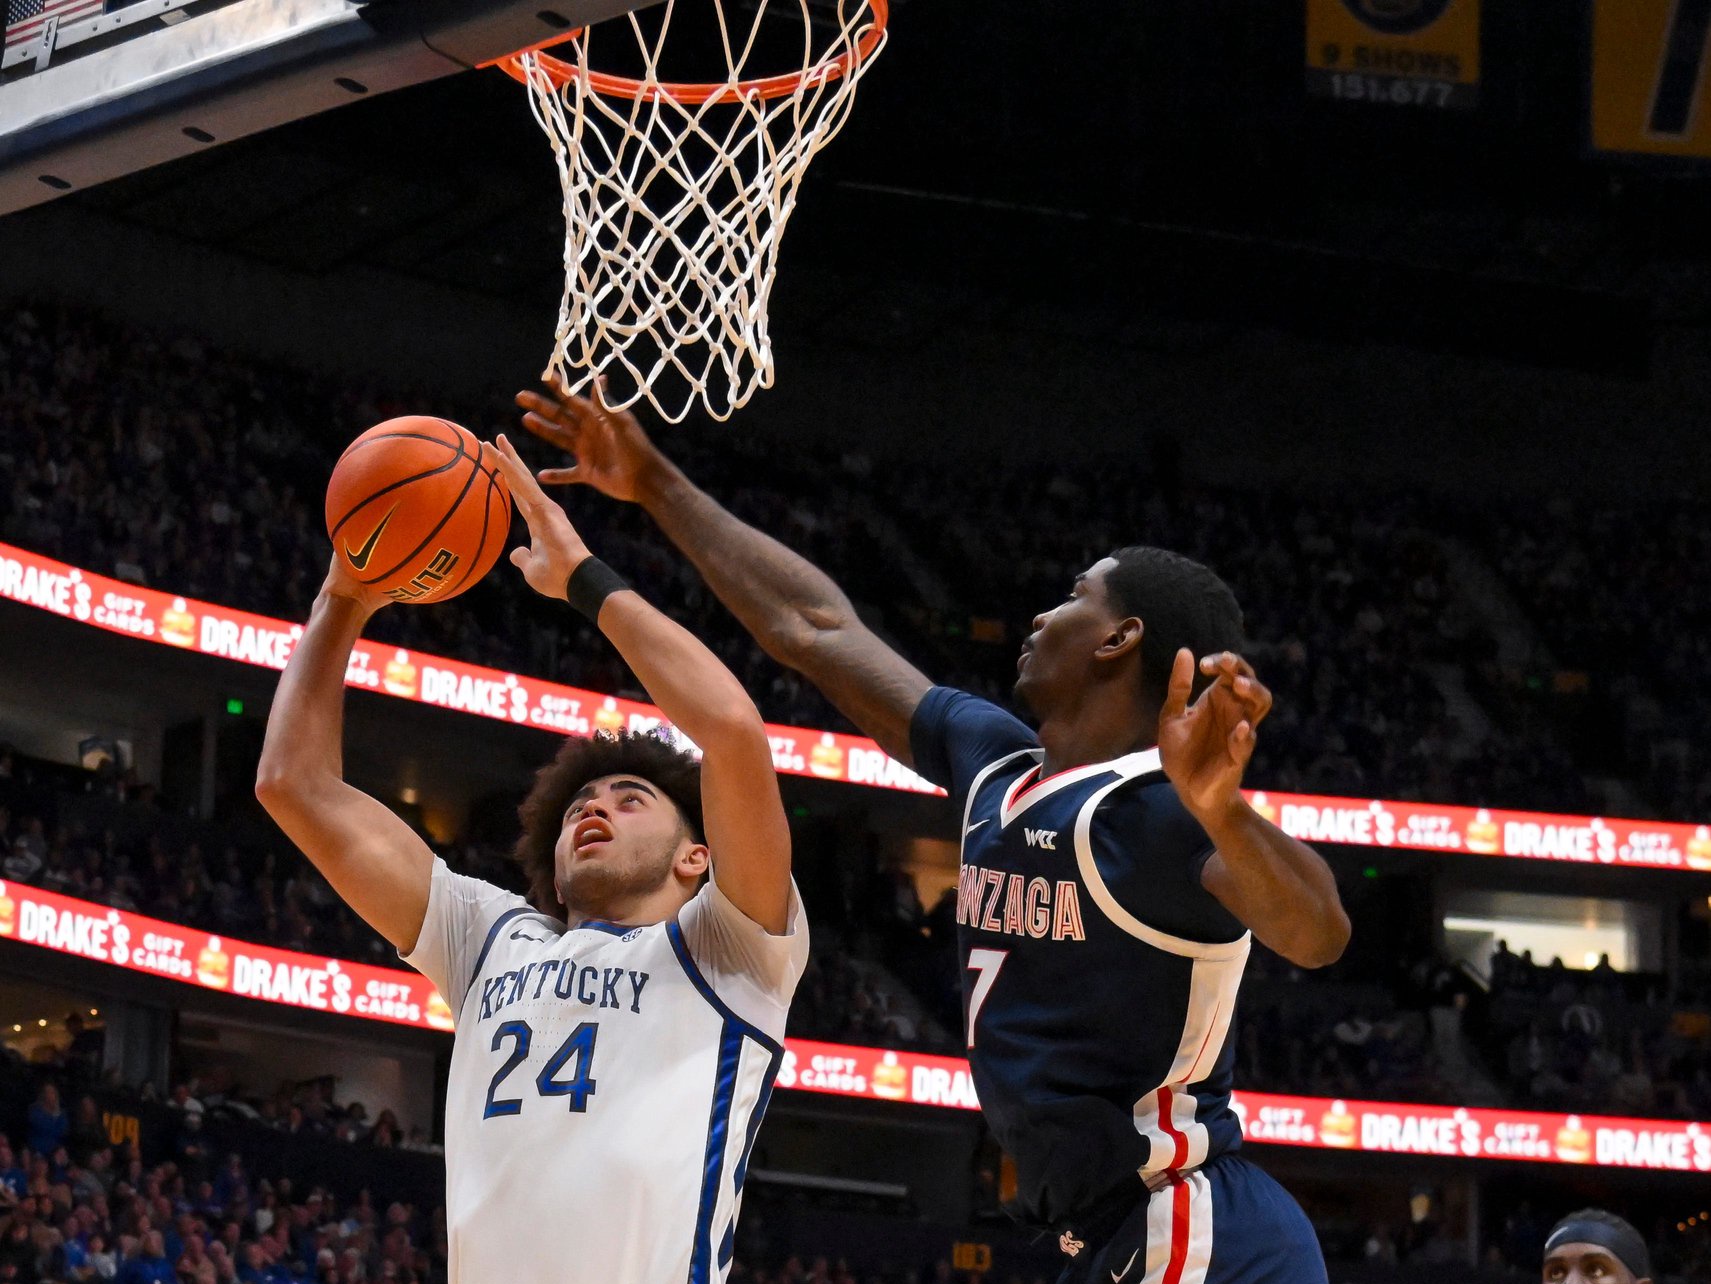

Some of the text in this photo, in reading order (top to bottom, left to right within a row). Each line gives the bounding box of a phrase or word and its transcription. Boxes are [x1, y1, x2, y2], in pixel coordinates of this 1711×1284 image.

[103, 592, 146, 617] GIFT
[93, 608, 155, 636] CARDS
[421, 666, 528, 723] DRAKE'S
[541, 694, 581, 715] GIFT
[530, 707, 589, 734] CARDS
[1280, 800, 1395, 846] DRAKE'S
[1408, 815, 1451, 834] GIFT
[1024, 827, 1058, 851] WCC
[1398, 829, 1461, 849] CARDS
[1504, 817, 1616, 863] DRAKE'S
[1628, 831, 1671, 849] GIFT
[1618, 845, 1682, 866] CARDS
[19, 900, 131, 965] DRAKE'S
[143, 932, 184, 954] GIFT
[132, 948, 192, 978] CARDS
[233, 955, 352, 1013] DRAKE'S
[366, 981, 412, 1002] GIFT
[478, 958, 649, 1024] KENTUCKY
[355, 997, 420, 1022] CARDS
[967, 947, 1010, 1050] 7
[483, 1020, 599, 1120] 24
[811, 1055, 857, 1073] GIFT
[800, 1068, 867, 1093] CARDS
[1259, 1106, 1304, 1124] GIFT
[1249, 1121, 1315, 1142] CARDS
[1361, 1108, 1481, 1156] DRAKE'S
[1494, 1122, 1540, 1140] GIFT
[1484, 1136, 1550, 1157] CARDS
